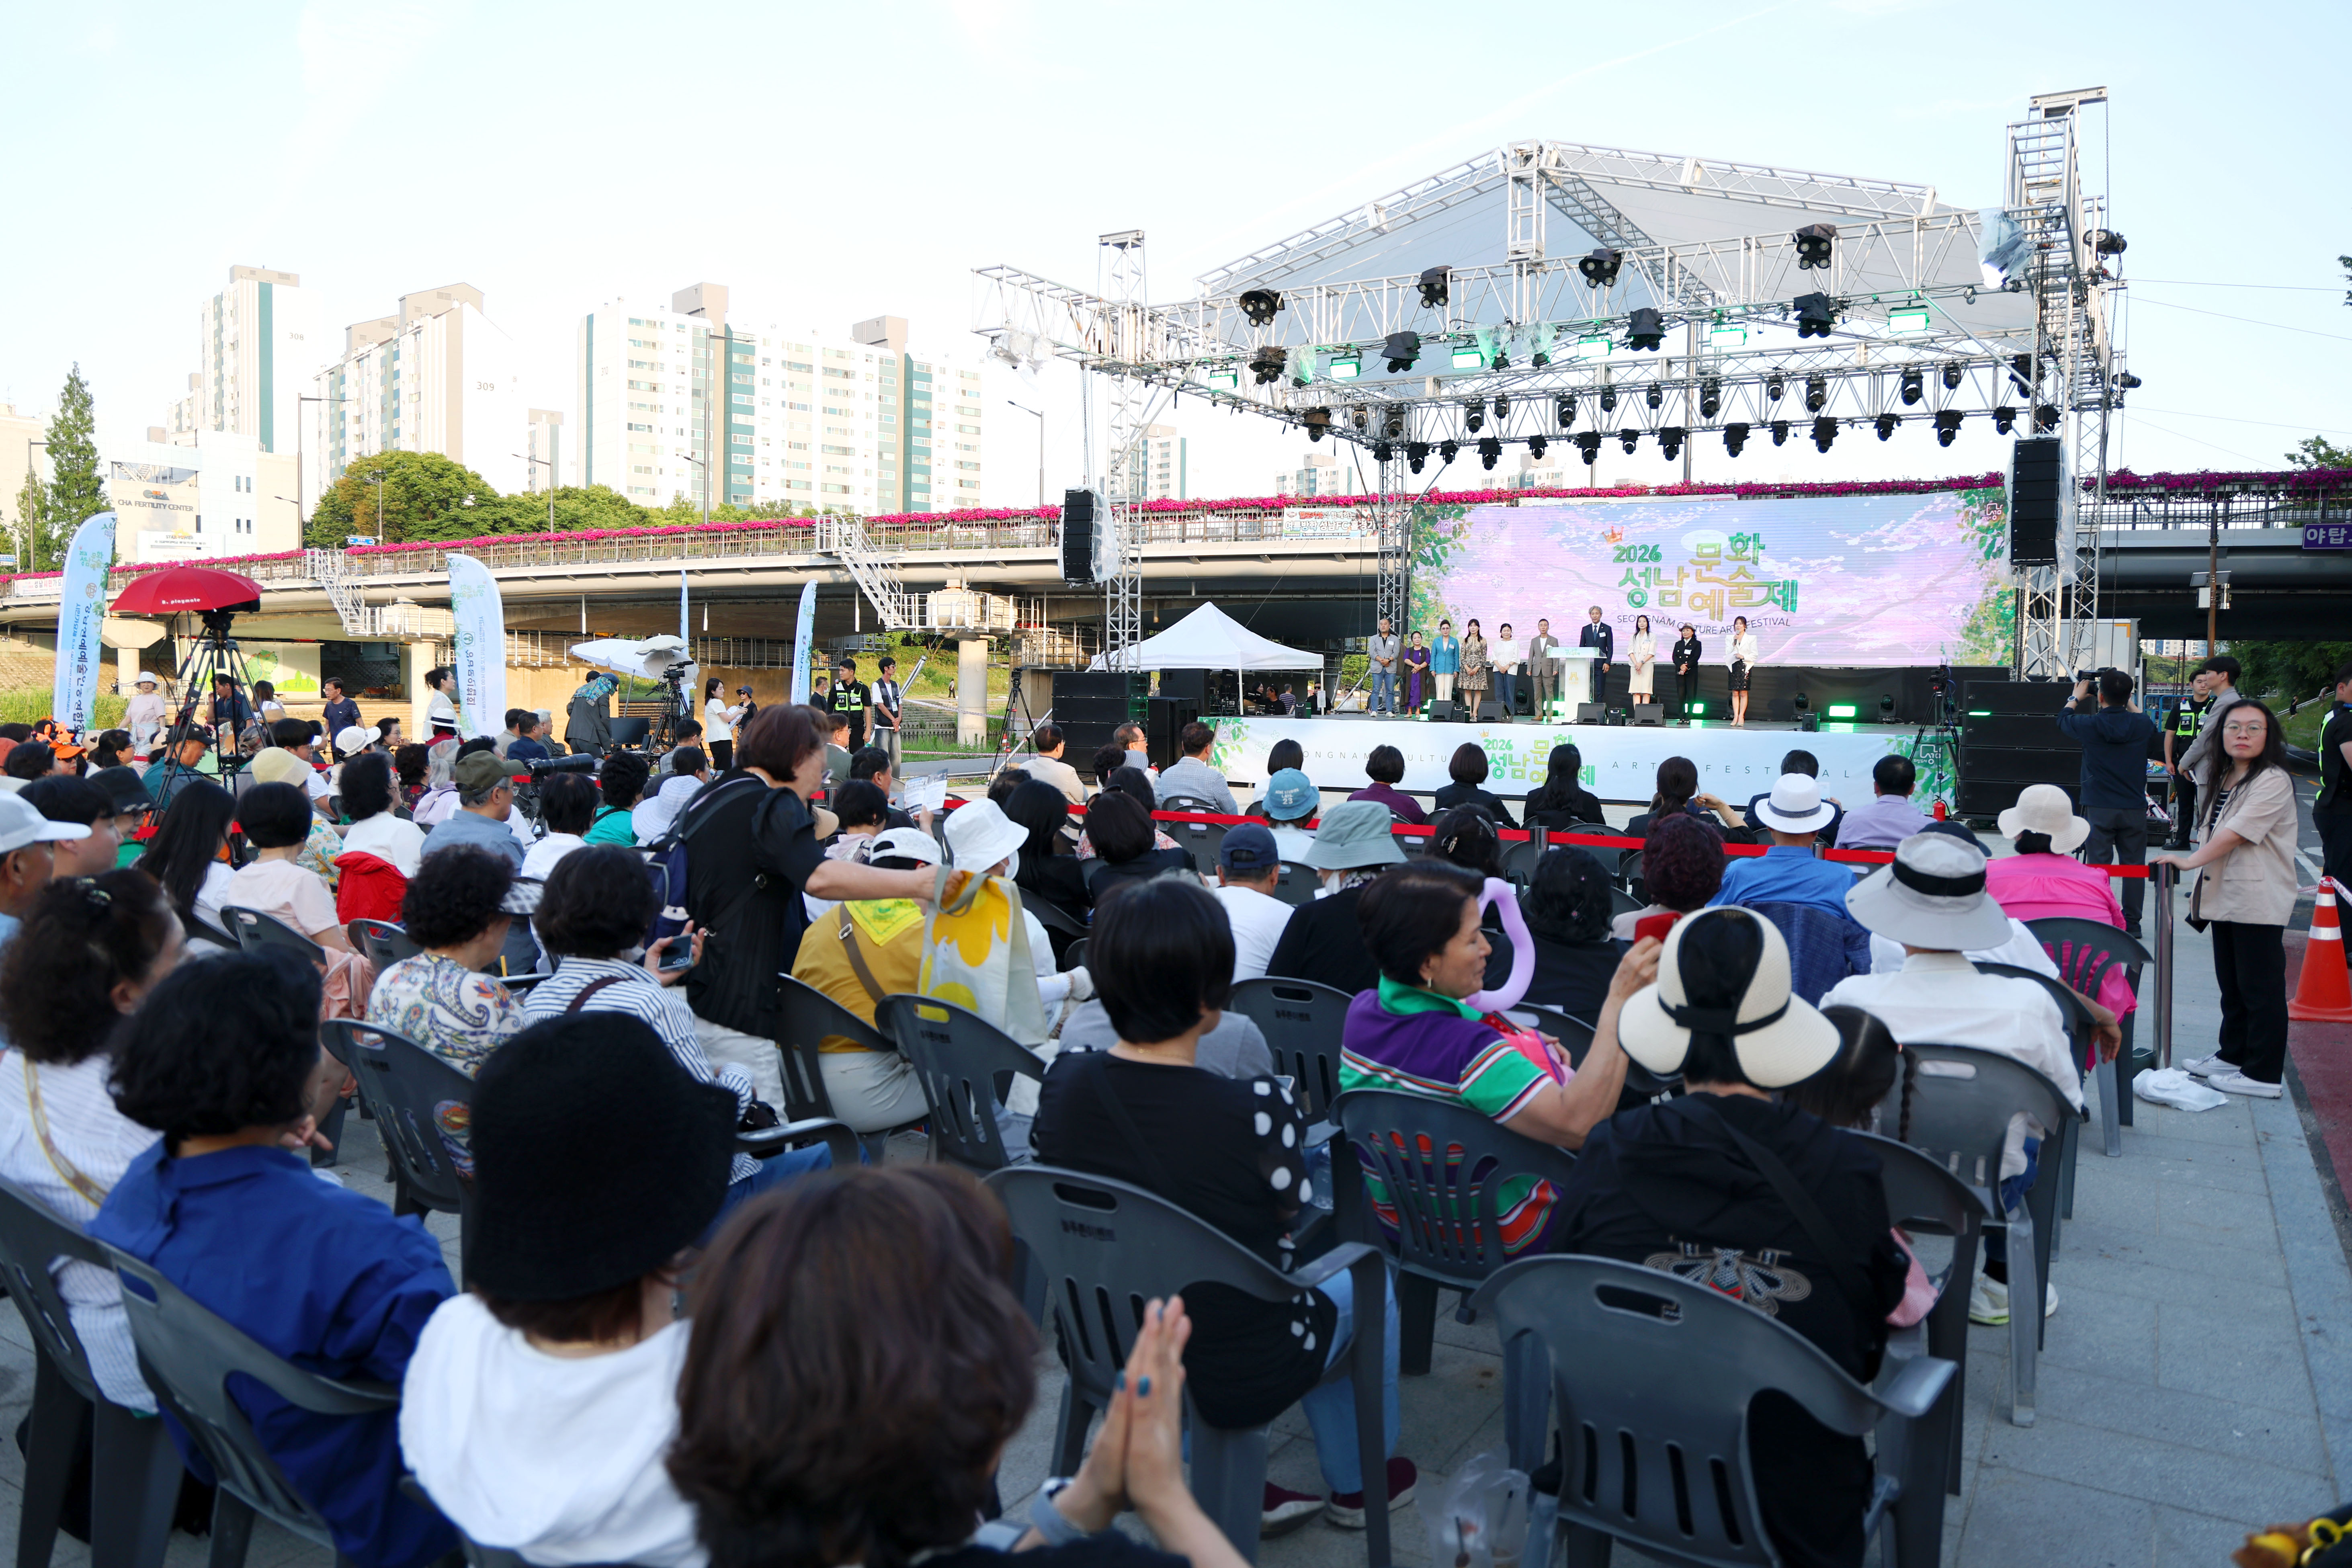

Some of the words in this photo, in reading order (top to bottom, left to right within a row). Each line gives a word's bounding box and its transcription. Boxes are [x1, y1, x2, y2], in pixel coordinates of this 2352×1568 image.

[289, 332, 304, 341] 308
[477, 382, 494, 391] 309
[135, 501, 167, 509] FERTILITY
[1331, 510, 1356, 519] 함께하는
[1285, 521, 1318, 531] 여름방학
[1319, 520, 1348, 531] 성남FC
[1613, 544, 1662, 563] 2026
[1688, 532, 1765, 583] 문화
[1617, 615, 1676, 627] SEOGNAM
[1677, 621, 1717, 634] CTURE
[1483, 739, 1514, 751] 2026
[1303, 750, 1370, 760] ONGNAM
[1408, 754, 1447, 762] ULTU
[1705, 765, 1849, 778] FESTAL
